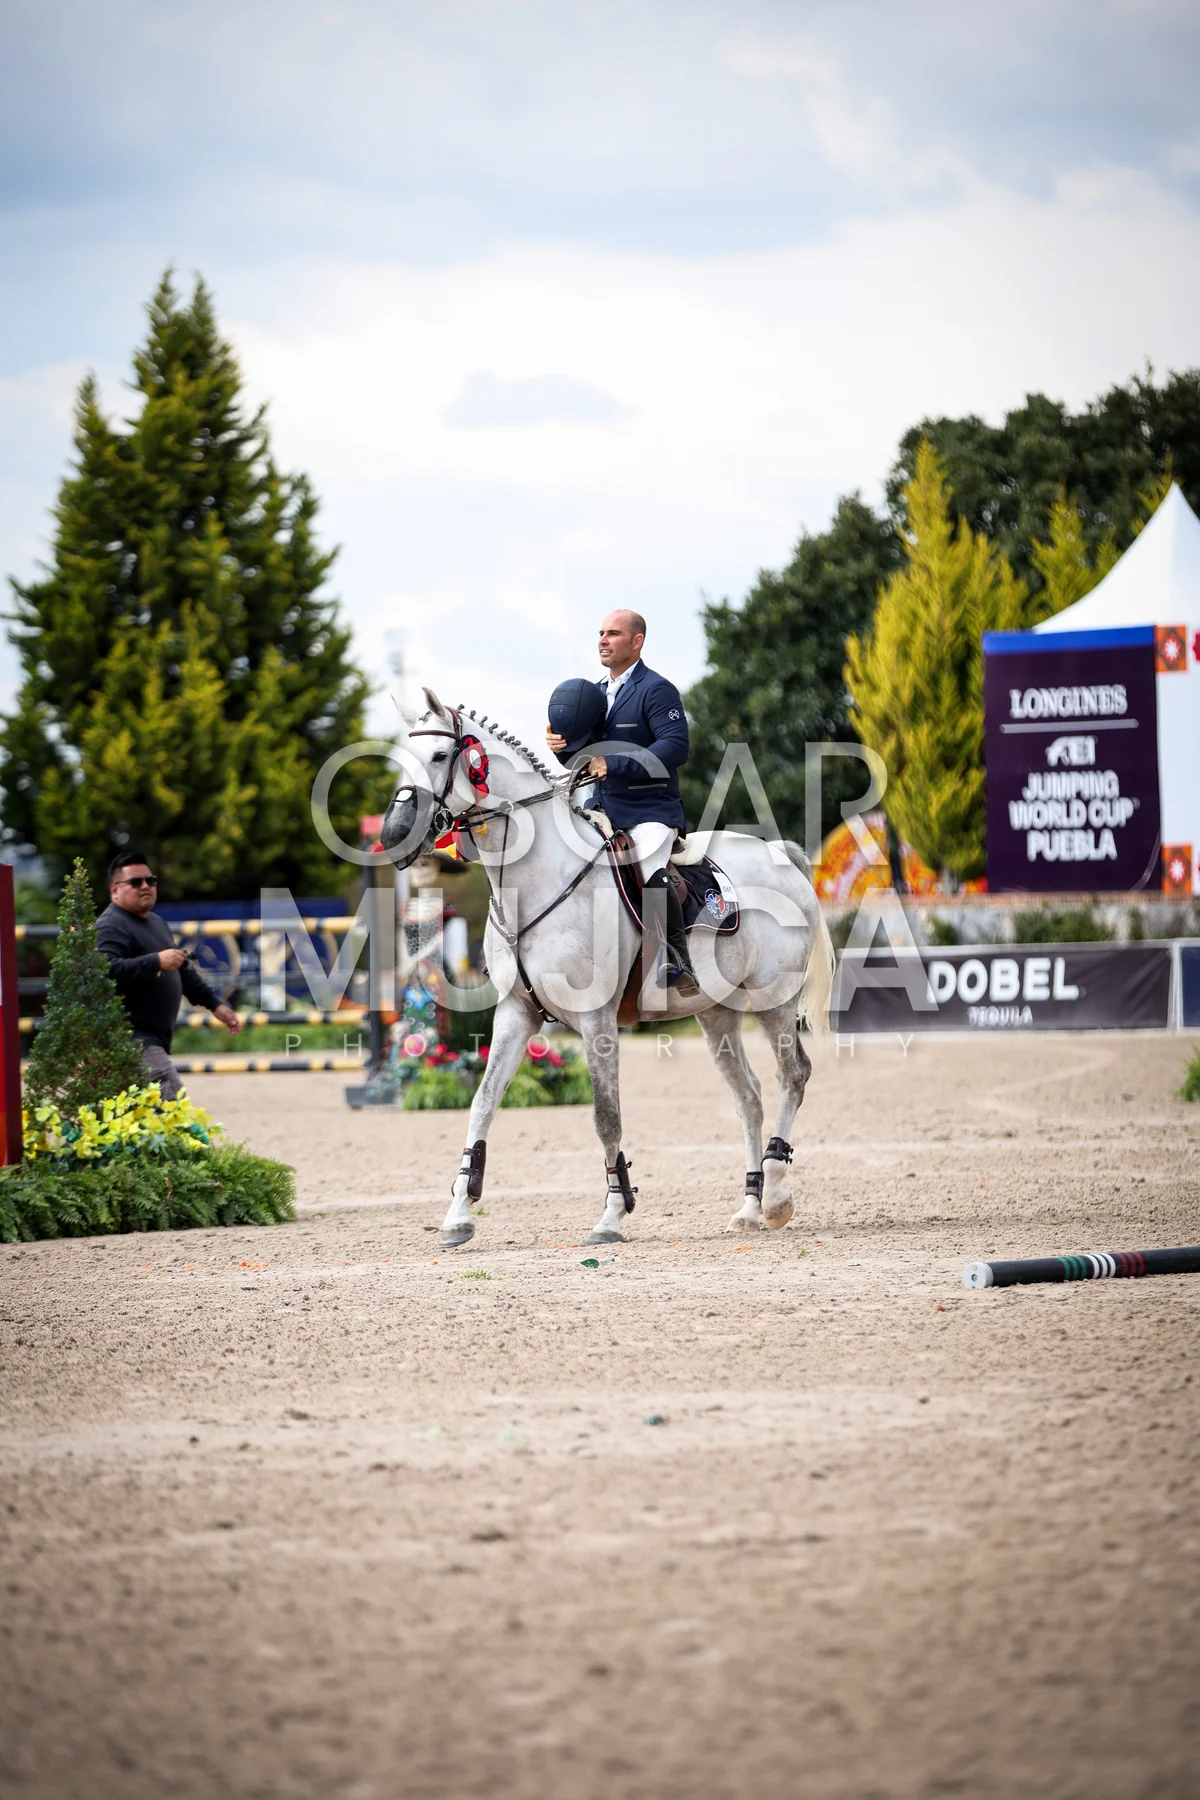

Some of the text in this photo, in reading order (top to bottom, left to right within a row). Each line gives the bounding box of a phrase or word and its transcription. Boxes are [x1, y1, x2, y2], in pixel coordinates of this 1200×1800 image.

[1009, 684, 1128, 719] LONGINES
[1022, 770, 1119, 801] JUMPING
[1008, 800, 1087, 830] WORLD
[1027, 829, 1117, 862] PUEBLA
[926, 957, 1080, 1004] DOBEL
[968, 1005, 1033, 1027] TEQUILA
